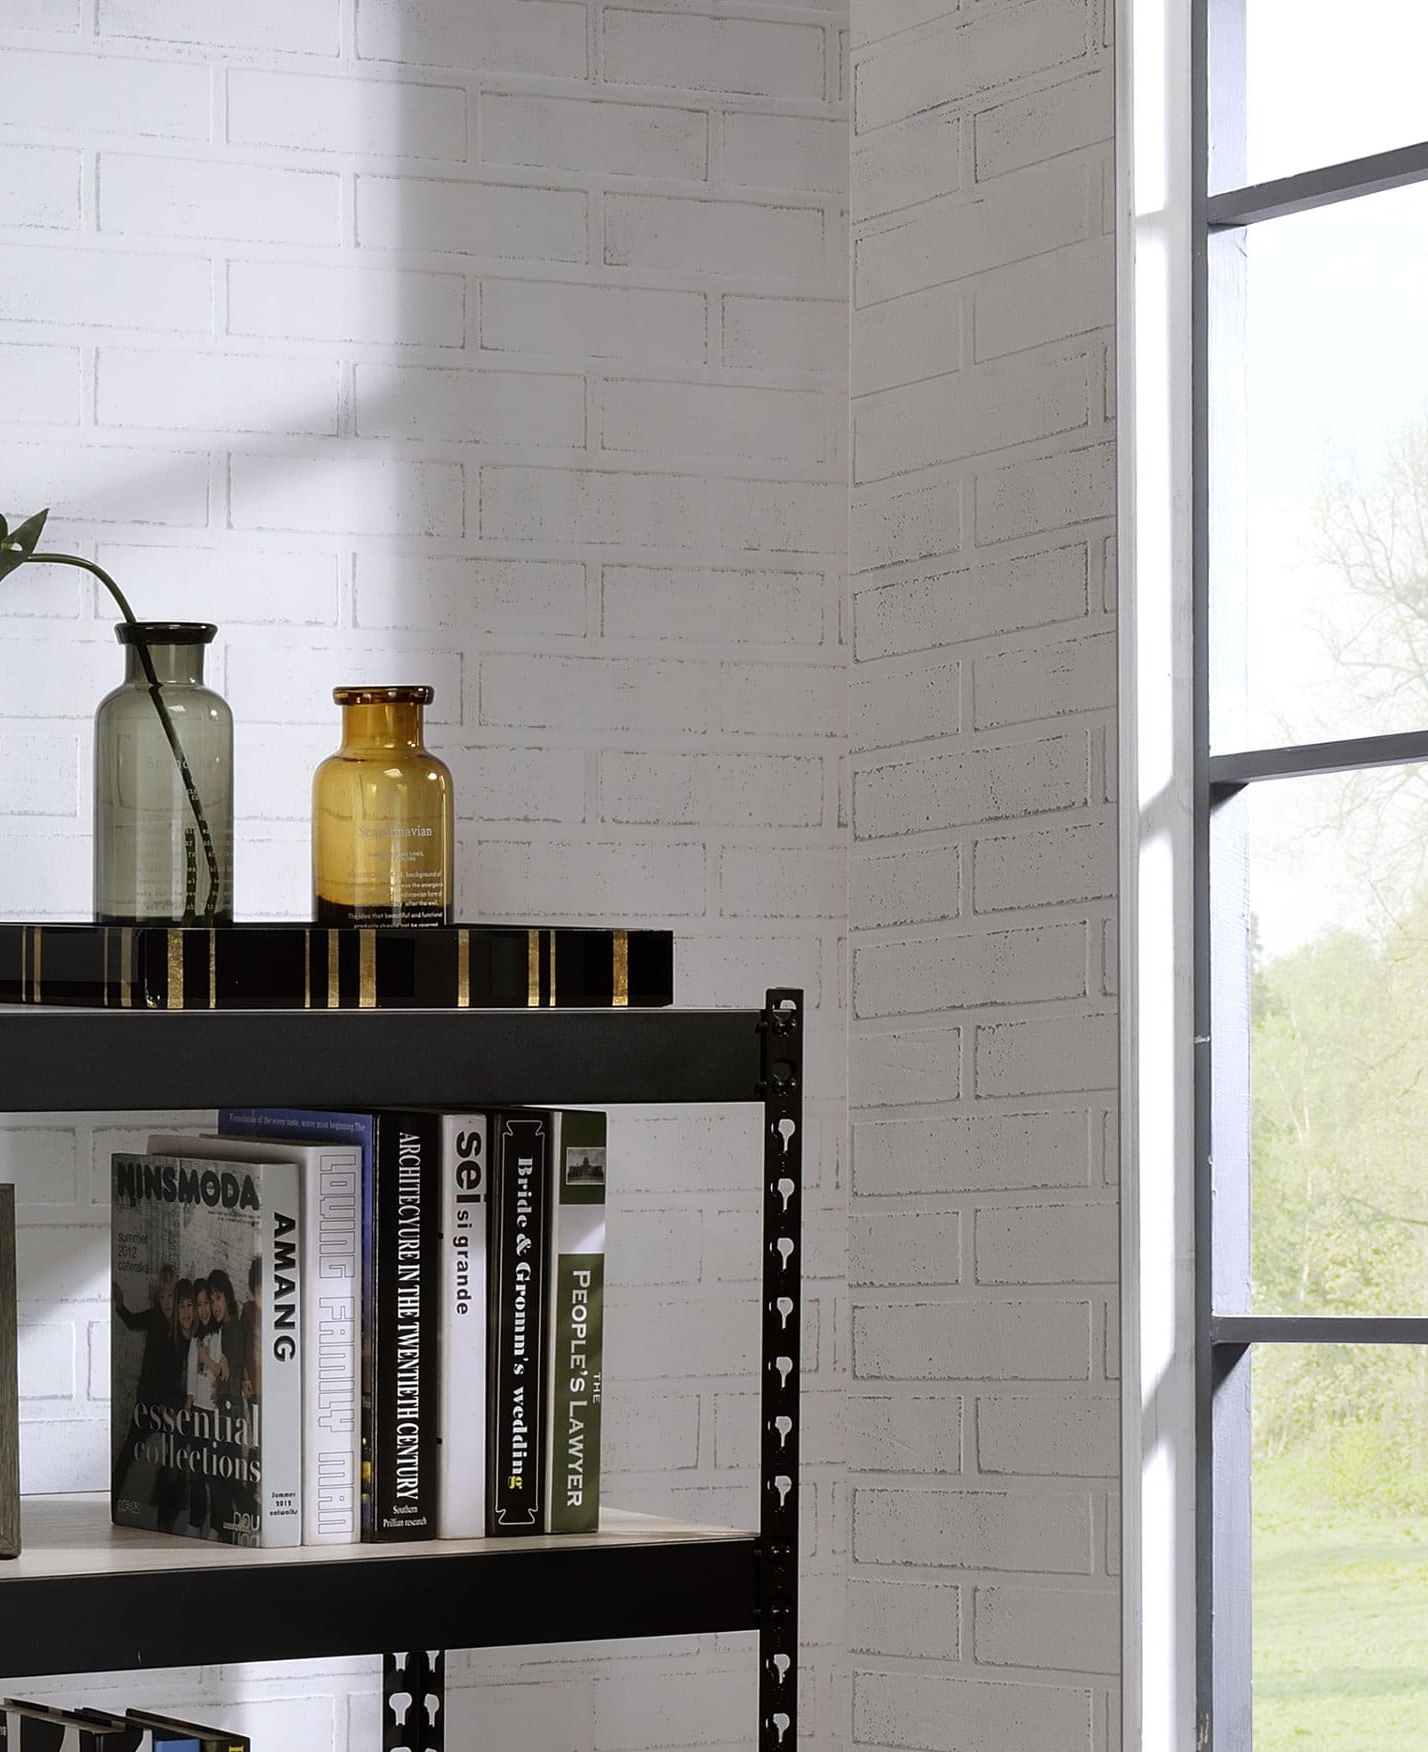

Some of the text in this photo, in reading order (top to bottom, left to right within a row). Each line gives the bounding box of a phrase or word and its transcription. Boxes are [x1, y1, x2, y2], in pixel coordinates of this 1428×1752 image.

[358, 824, 433, 837] Scdinavian
[516, 1157, 533, 1228] Bride
[117, 1232, 148, 1244] summer
[117, 1246, 138, 1258] 2012
[515, 1233, 532, 1257] &
[273, 1212, 297, 1363] AMANG
[453, 1236, 472, 1315] grande
[396, 1131, 421, 1500] ARCHITECYURE IN THE TWENTIETH CENTURY
[592, 1371, 602, 1404] THE
[133, 1400, 261, 1448] essential
[508, 1386, 528, 1490] wedding
[134, 1432, 262, 1483] collections
[567, 1400, 588, 1507] LAWYER
[393, 1504, 418, 1515] Southern
[404, 1516, 428, 1527] research
